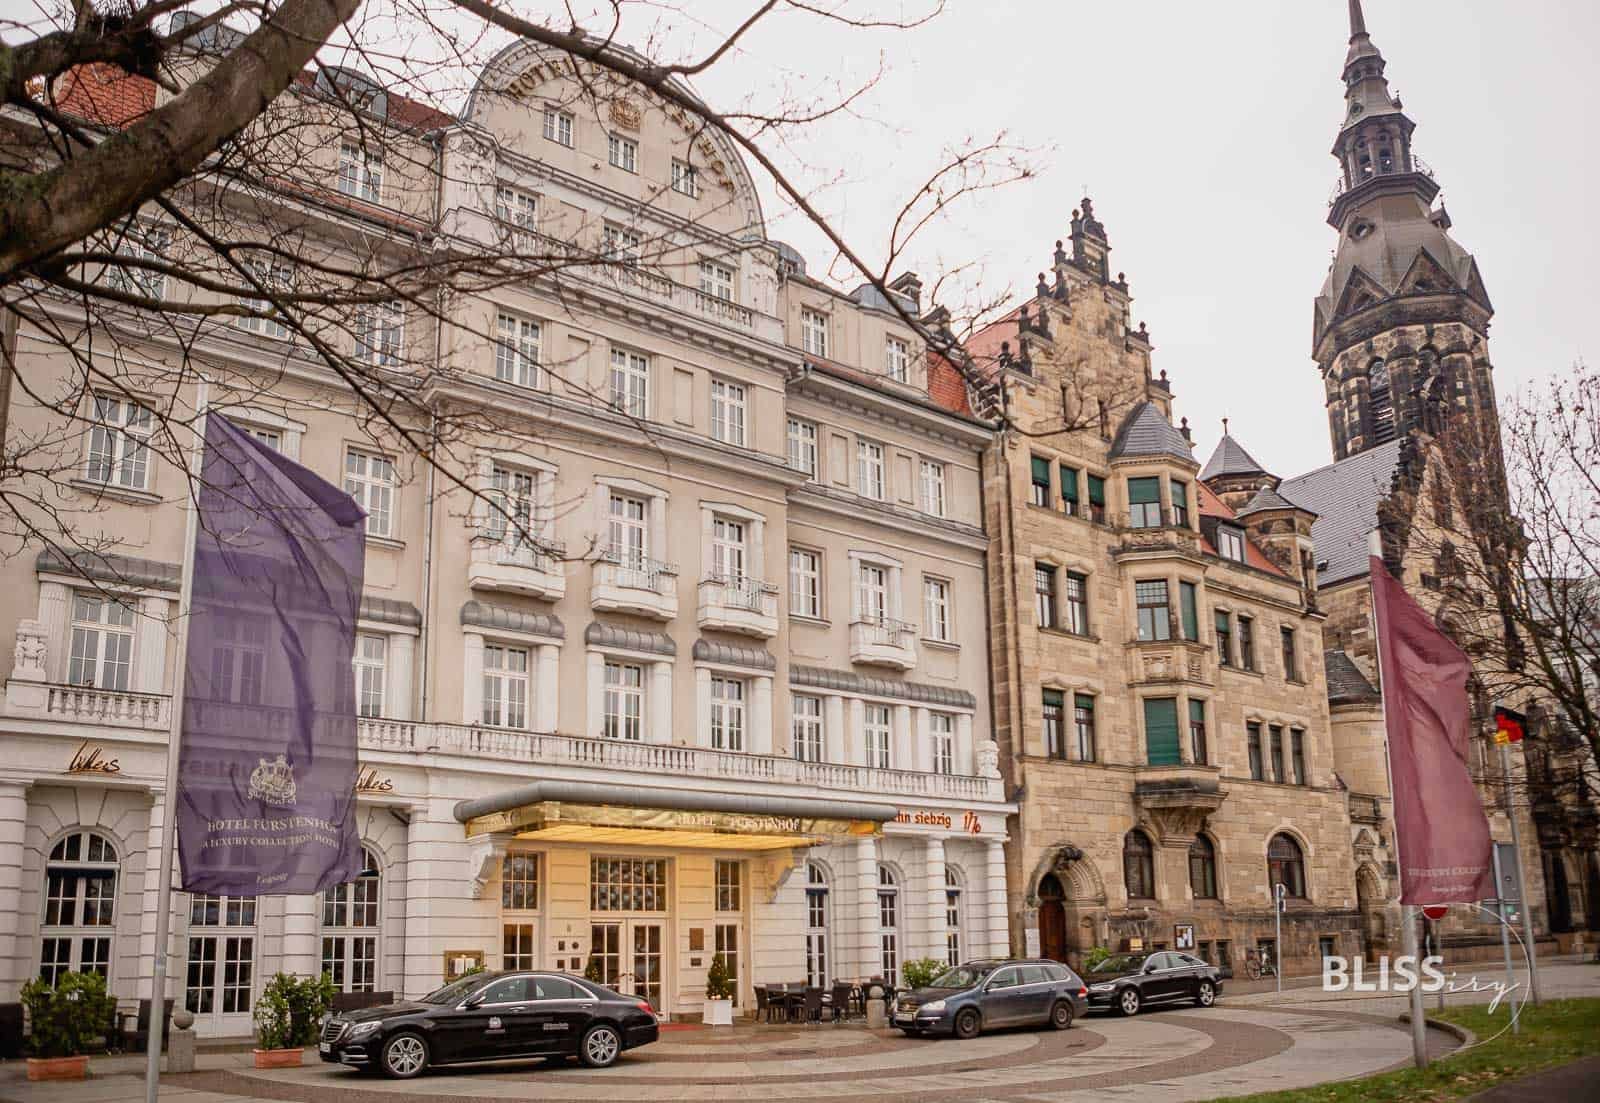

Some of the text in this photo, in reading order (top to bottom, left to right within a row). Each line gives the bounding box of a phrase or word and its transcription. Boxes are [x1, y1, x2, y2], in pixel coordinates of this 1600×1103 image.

[207, 818, 250, 833] HOTEL
[895, 810, 952, 829] hn siebzig
